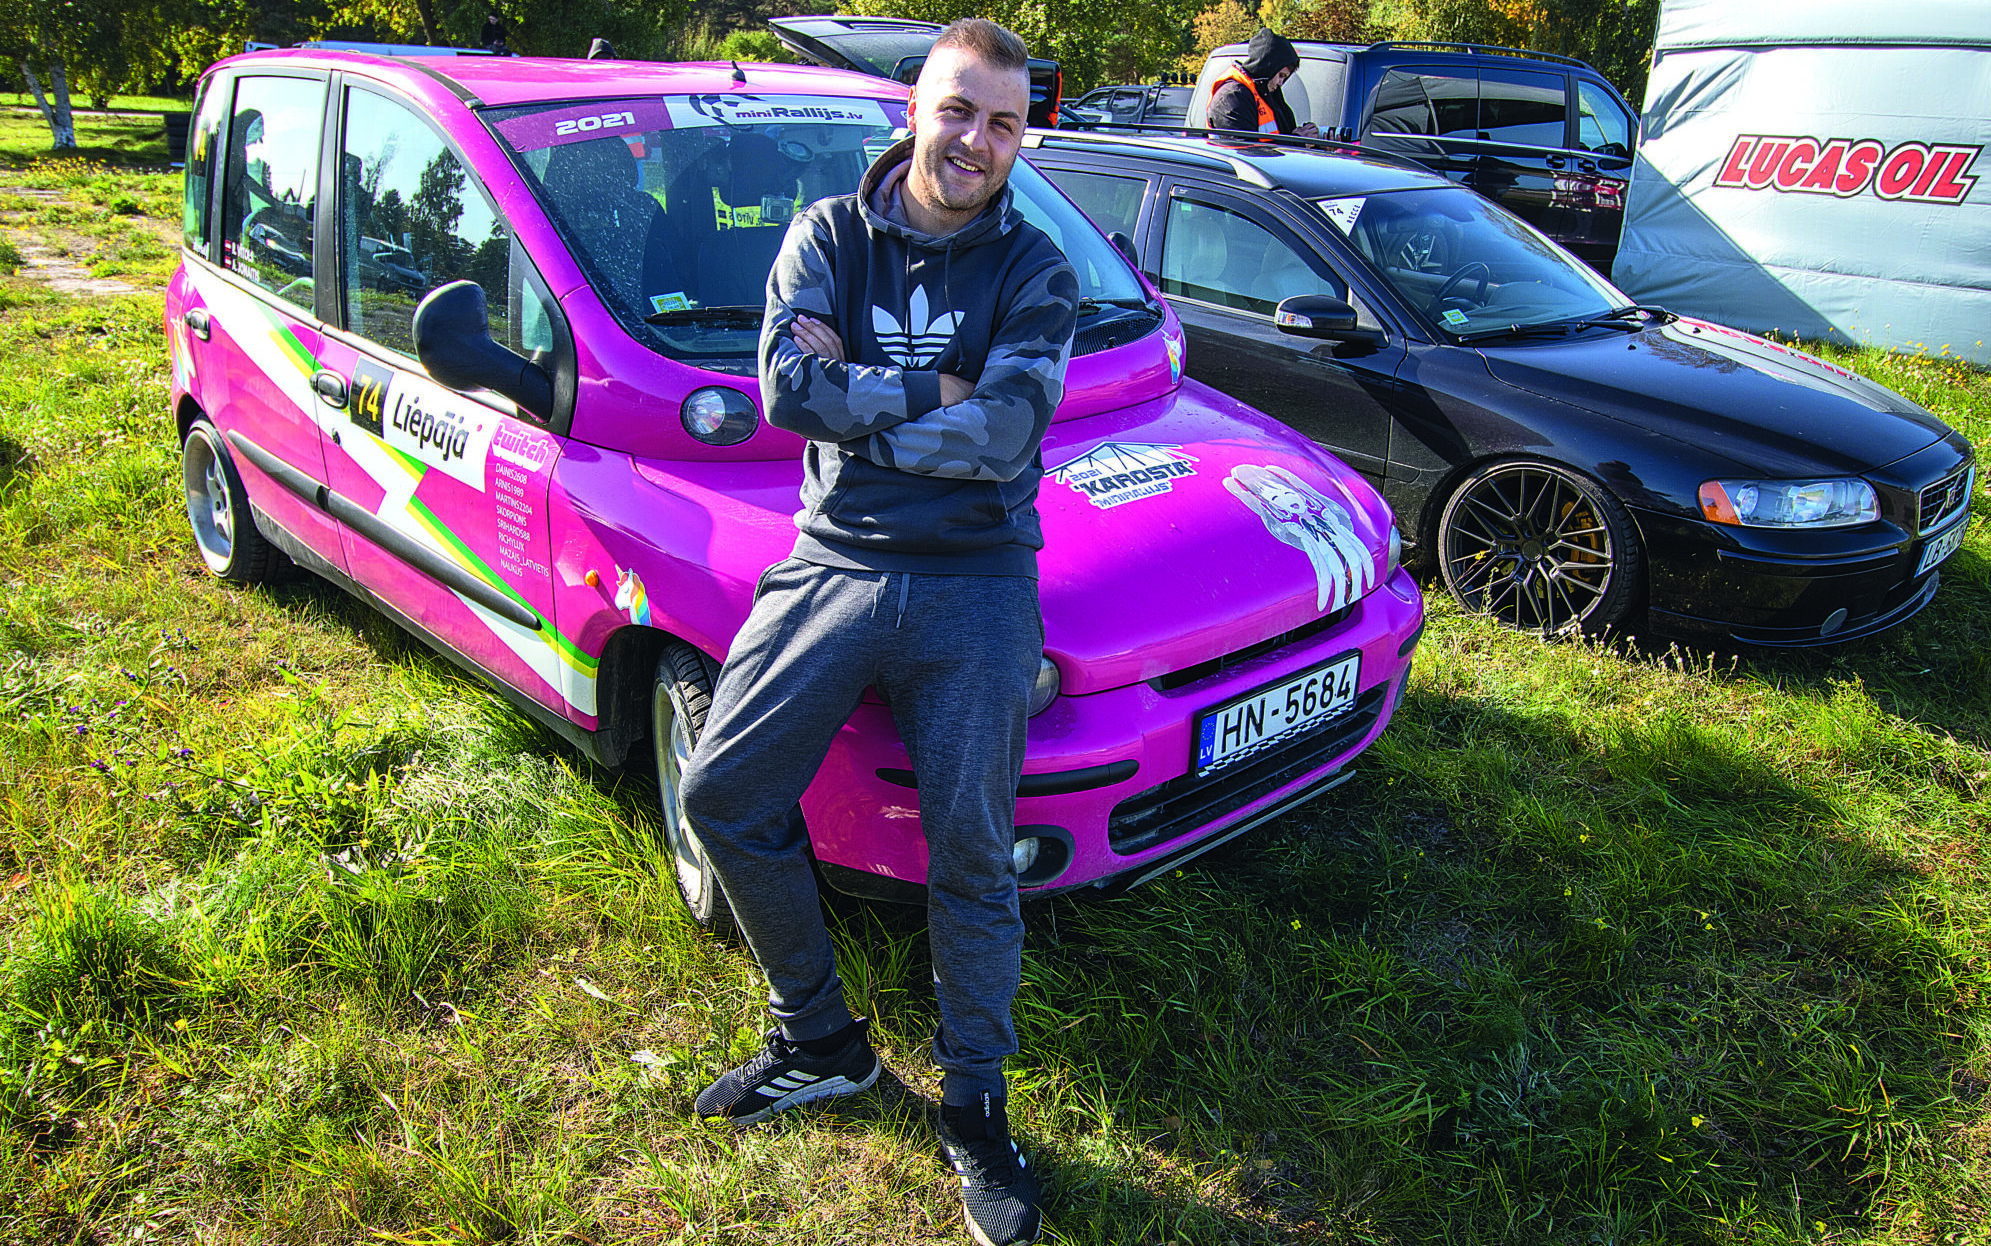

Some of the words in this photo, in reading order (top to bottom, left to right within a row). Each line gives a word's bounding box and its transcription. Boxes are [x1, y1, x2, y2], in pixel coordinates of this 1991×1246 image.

[556, 111, 636, 136] 2021
[735, 107, 863, 121] miniRallijs.lv
[1714, 136, 1883, 197] LUCAS
[1875, 143, 1981, 204] OIL
[358, 374, 382, 422] 74
[493, 423, 548, 465] twitch
[1069, 468, 1103, 482] 2021
[1221, 663, 1351, 754] HN-5684
[1200, 744, 1213, 760] LV
